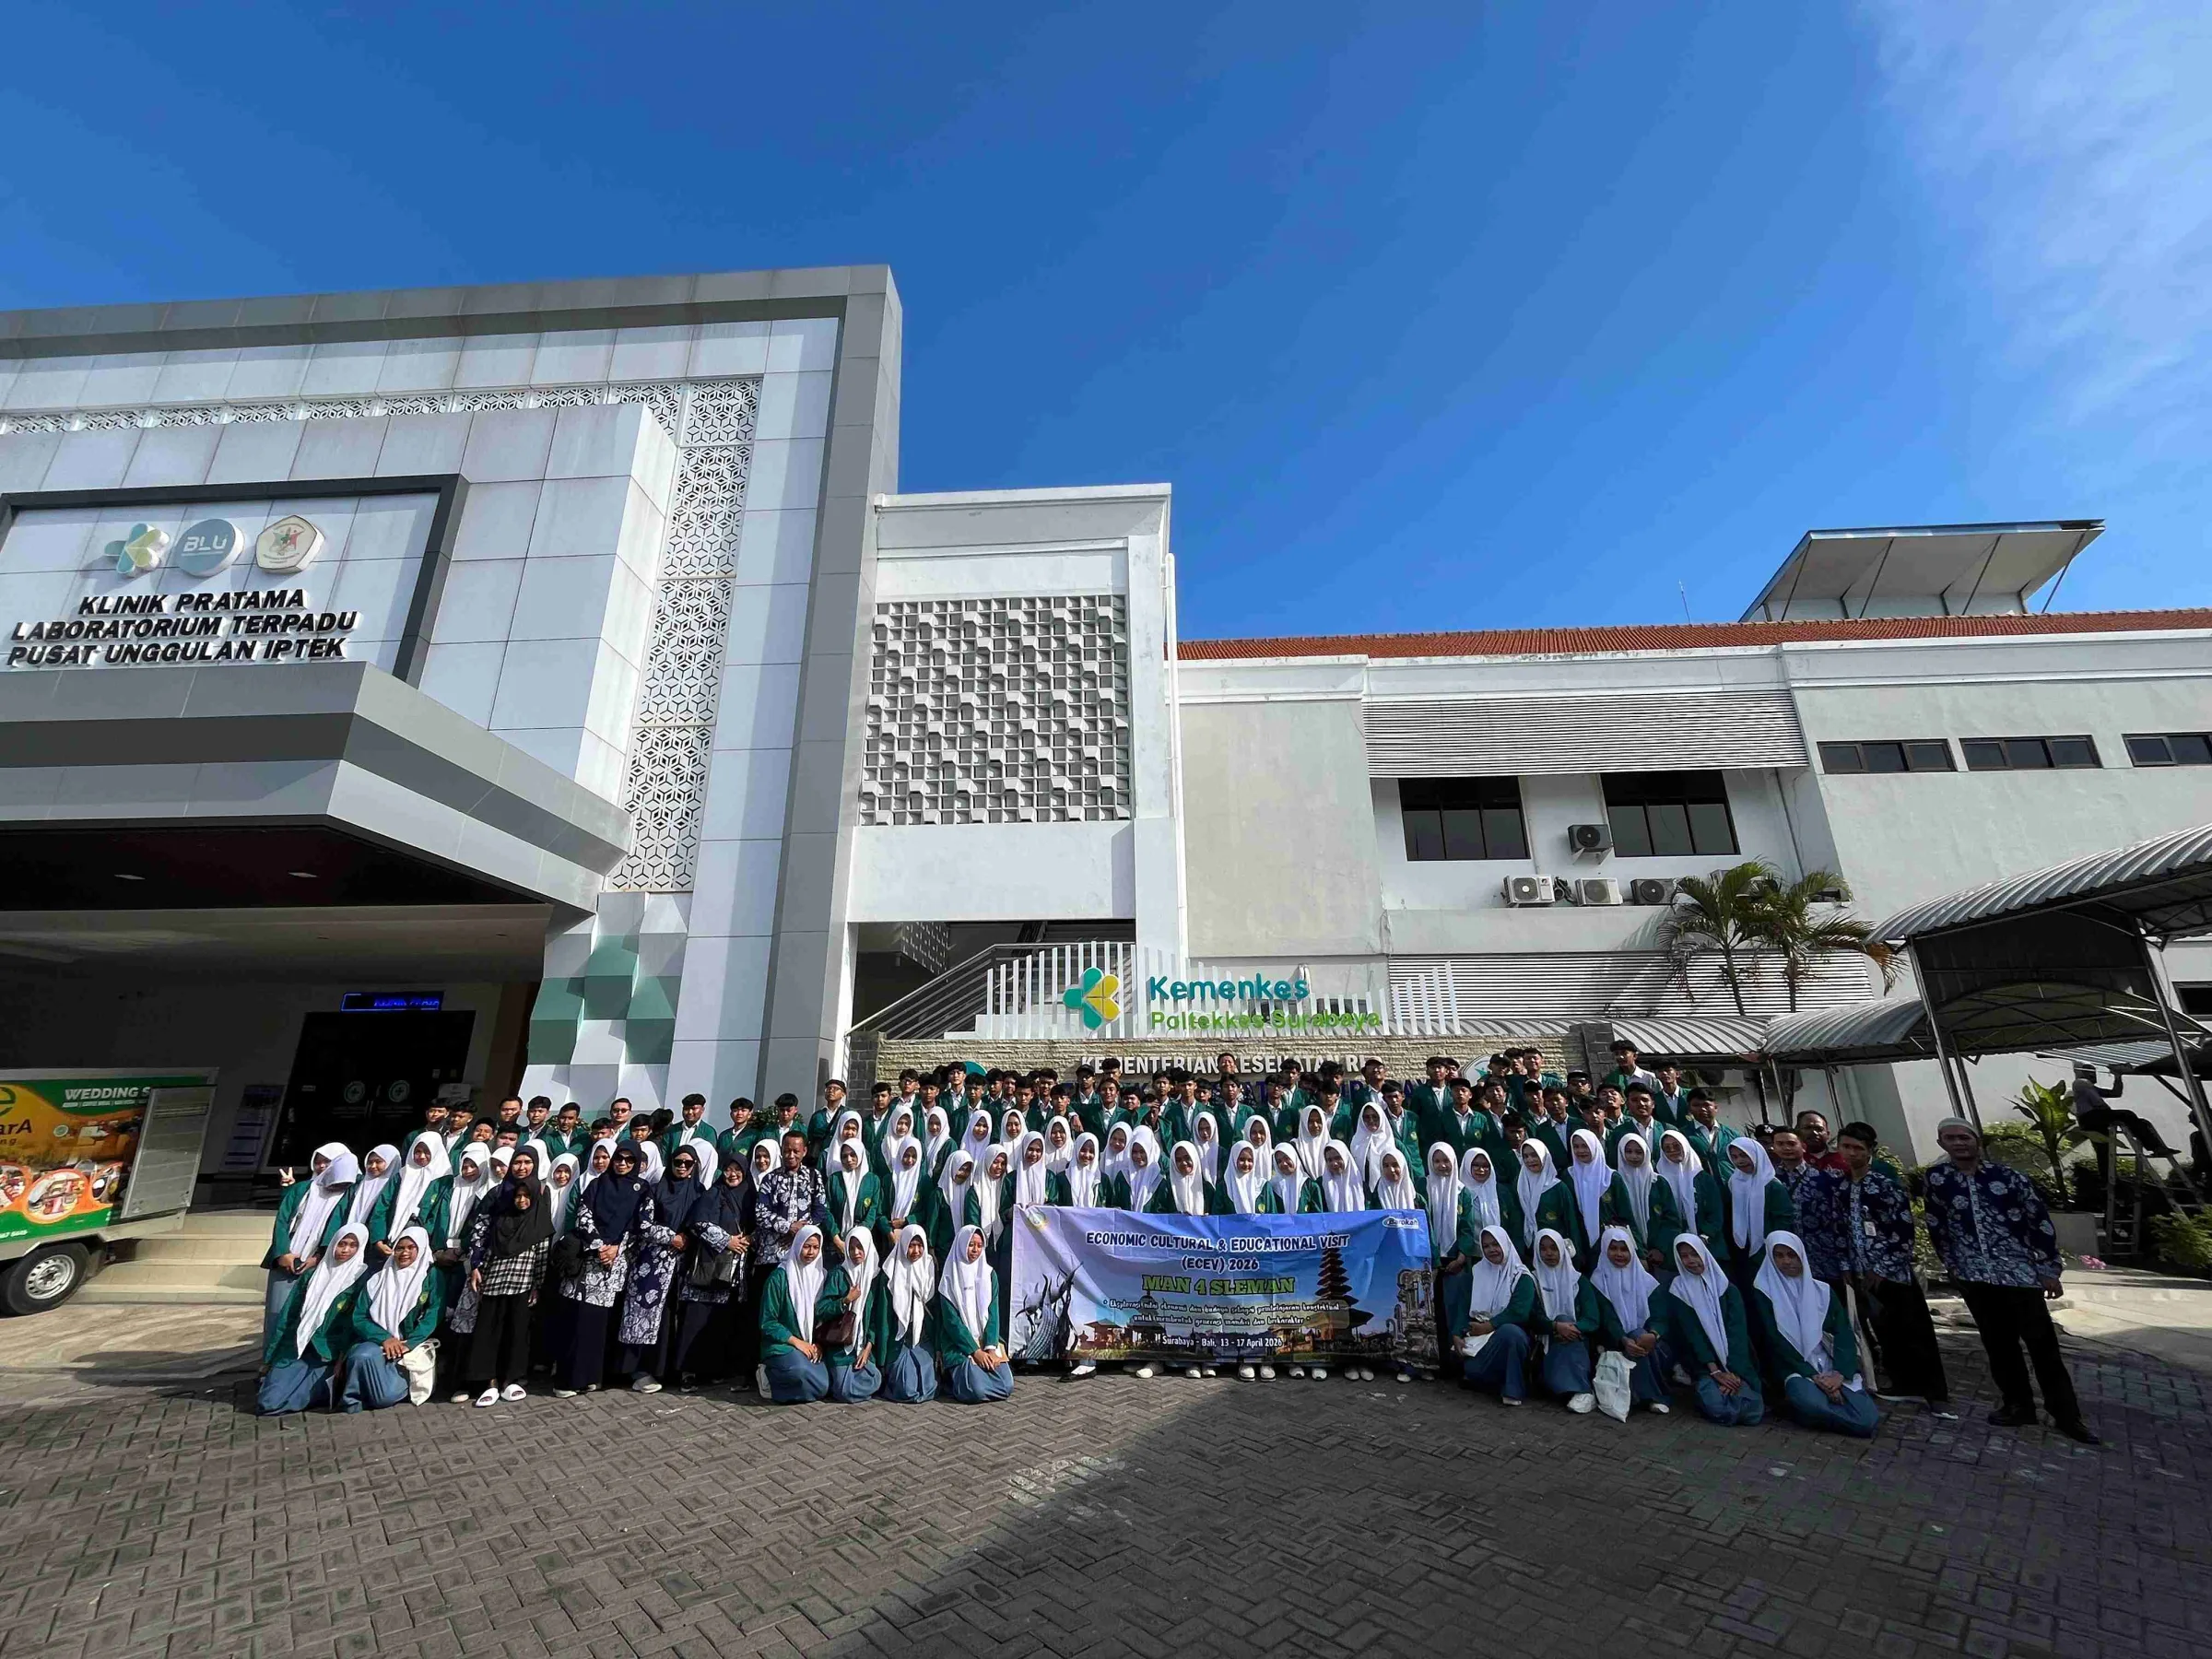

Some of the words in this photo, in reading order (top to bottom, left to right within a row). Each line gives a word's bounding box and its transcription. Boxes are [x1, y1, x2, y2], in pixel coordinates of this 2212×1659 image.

[185, 533, 228, 551] BLU
[77, 594, 169, 615] KLINIK
[176, 588, 305, 612] PRATAMA
[11, 617, 223, 641] LABORATORIUM
[232, 611, 358, 635] TERPADU
[6, 644, 98, 665] PUSAT
[104, 640, 258, 664] UNGGULAN
[264, 638, 347, 659] IPTEK
[1149, 973, 1310, 1001] Kemenkes
[1151, 1009, 1265, 1030] Poltekkes
[1271, 1009, 1381, 1032] Surabaya
[1231, 1054, 1340, 1074] ESEATA
[65, 1087, 139, 1100] WEDDING
[1086, 1231, 1147, 1246] ECONOMIC
[1150, 1234, 1214, 1251] CULTURAL
[1218, 1239, 1228, 1252] &
[1230, 1236, 1316, 1252] EDUCATIONAL
[1319, 1234, 1349, 1249] VISIT
[1182, 1254, 1225, 1273] (ECEV)
[1228, 1257, 1259, 1271] 2026
[1142, 1275, 1192, 1294] MAN
[1194, 1278, 1207, 1295] 4
[1209, 1277, 1296, 1296] SLEMAN
[1162, 1335, 1194, 1347] Surabaya
[1201, 1337, 1217, 1347] Bali,
[1220, 1338, 1230, 1347] 13
[1237, 1338, 1245, 1347] 17
[1246, 1337, 1264, 1348] April
[1265, 1337, 1283, 1347] 2026
